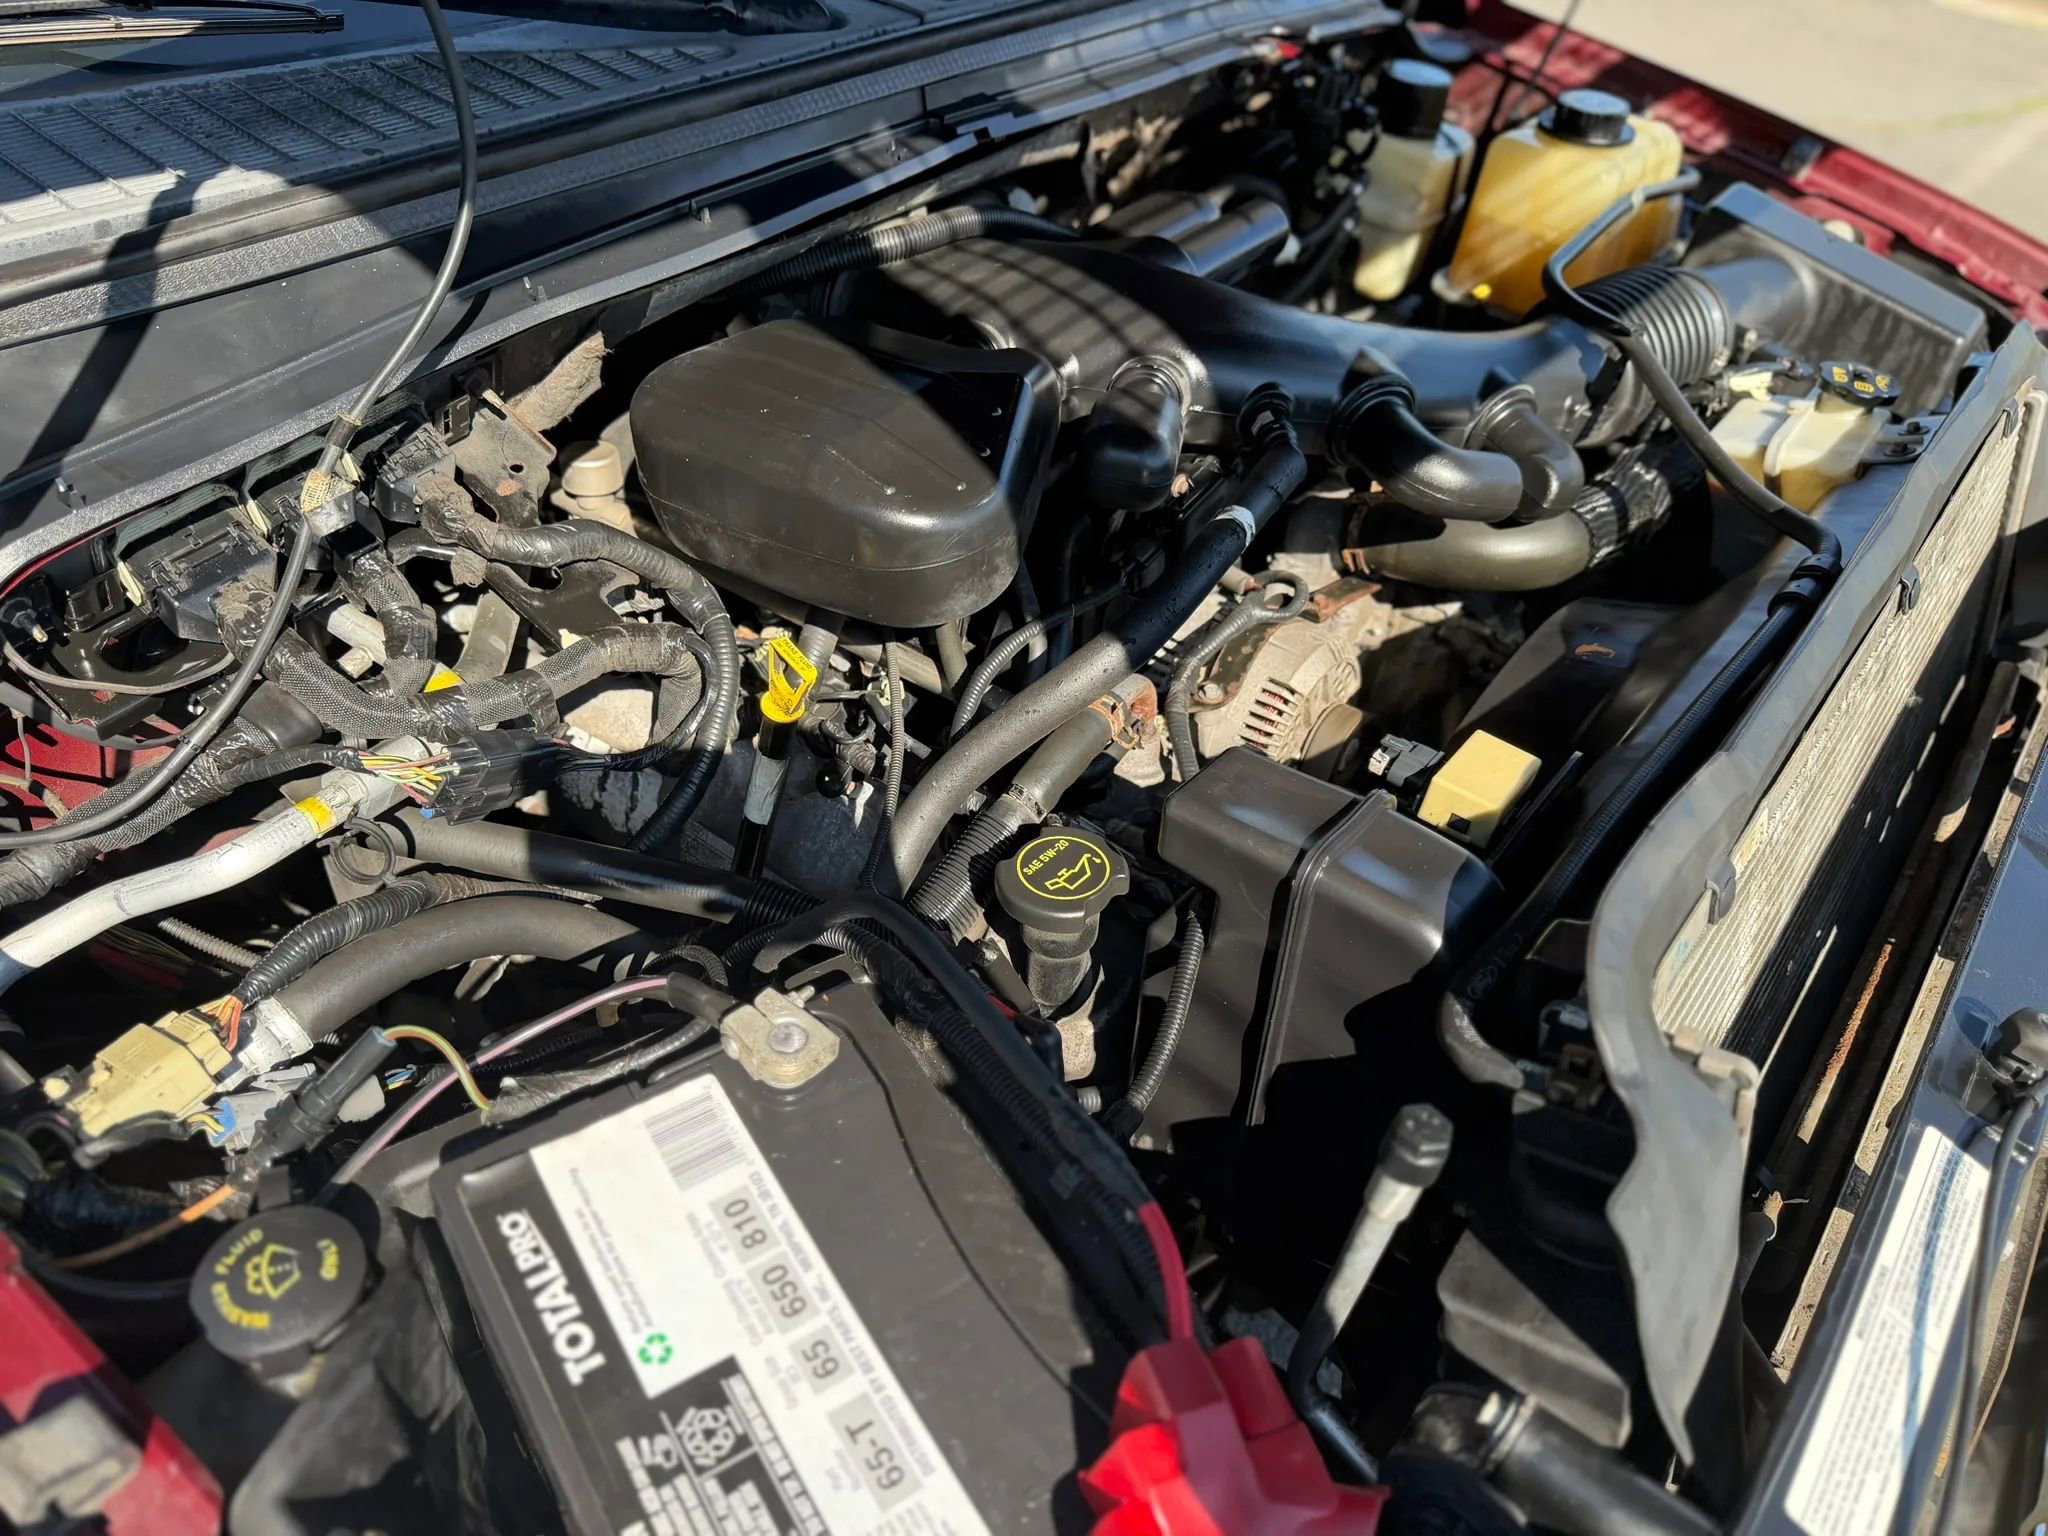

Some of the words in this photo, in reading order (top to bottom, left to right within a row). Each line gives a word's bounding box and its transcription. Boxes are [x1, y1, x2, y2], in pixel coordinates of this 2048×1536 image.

[1023, 860, 1044, 876] SAE
[1040, 839, 1070, 863] 5W-20
[723, 1196, 767, 1251] 810
[497, 1209, 606, 1385] TOTALPRO
[760, 1262, 808, 1320] 650
[801, 1337, 840, 1381] 65
[849, 1343, 874, 1376] BEST
[845, 1413, 906, 1493] 65-T
